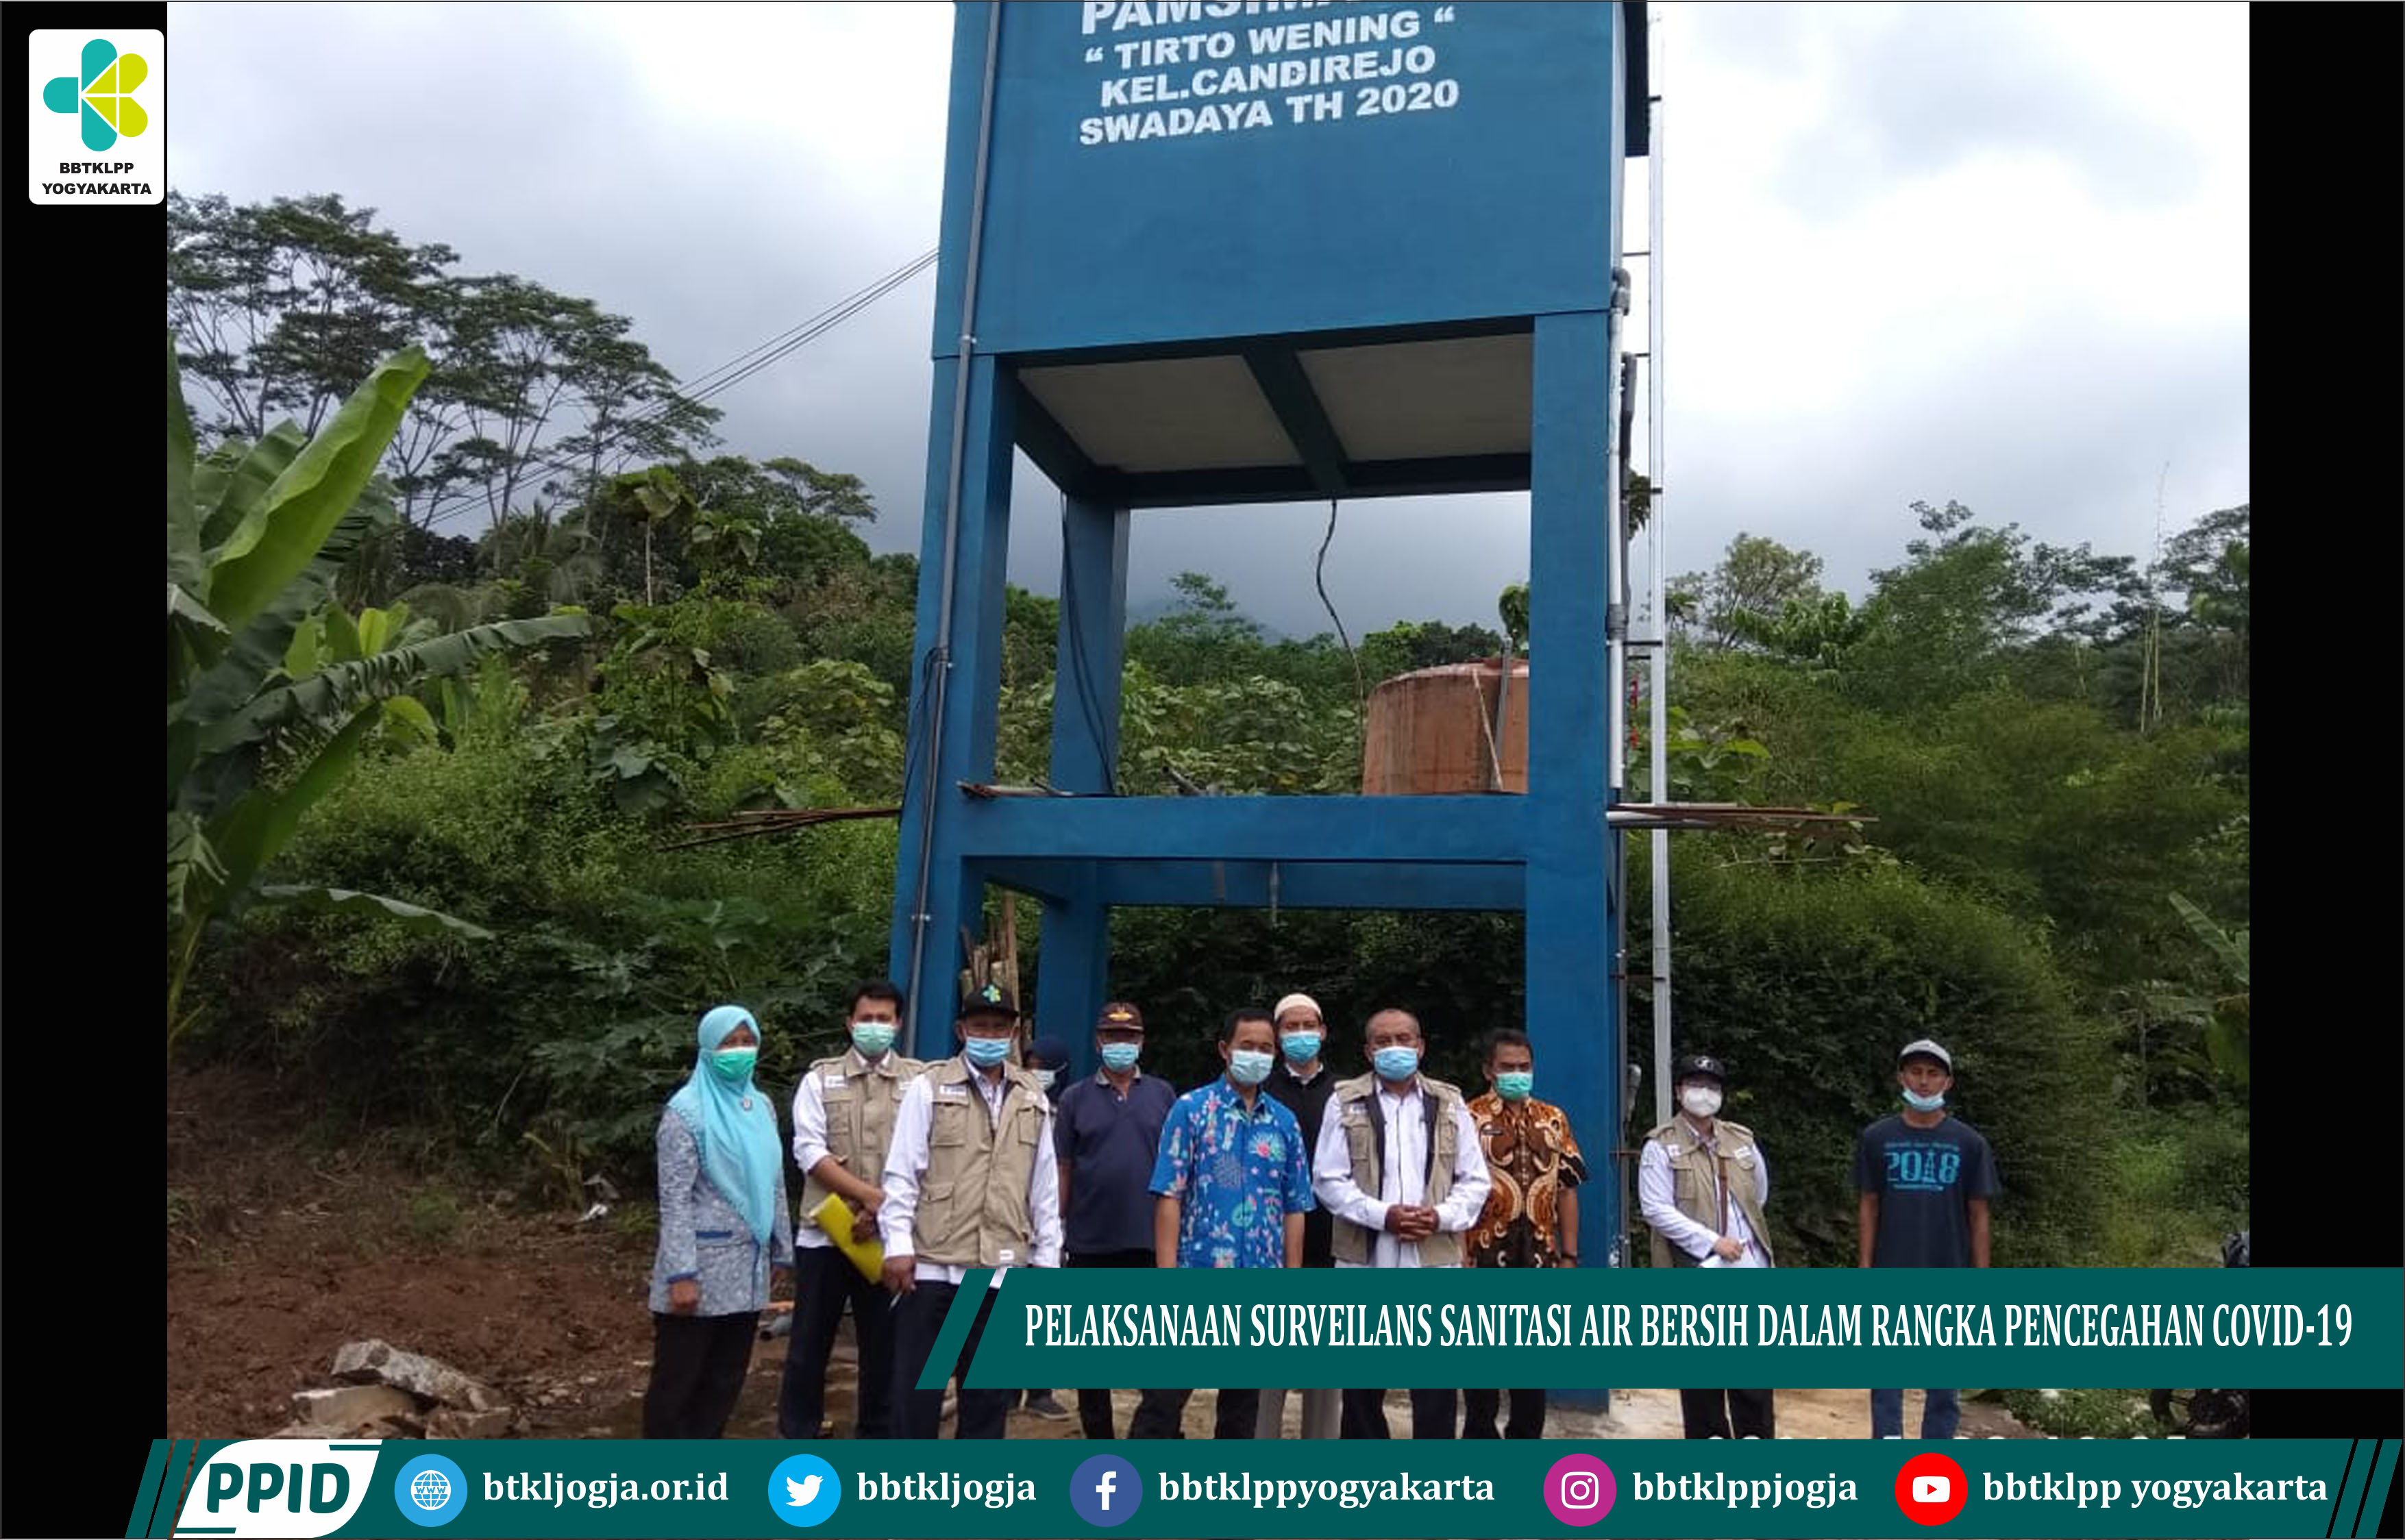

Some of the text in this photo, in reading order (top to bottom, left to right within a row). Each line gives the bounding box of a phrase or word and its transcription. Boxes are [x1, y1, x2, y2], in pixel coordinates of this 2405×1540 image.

[1114, 32, 1235, 69] TIRTO
[1248, 10, 1420, 55] WENING
[1101, 45, 1435, 107] KEL.CANDIREJO
[1080, 79, 1459, 145] SWADAYA TH 2020
